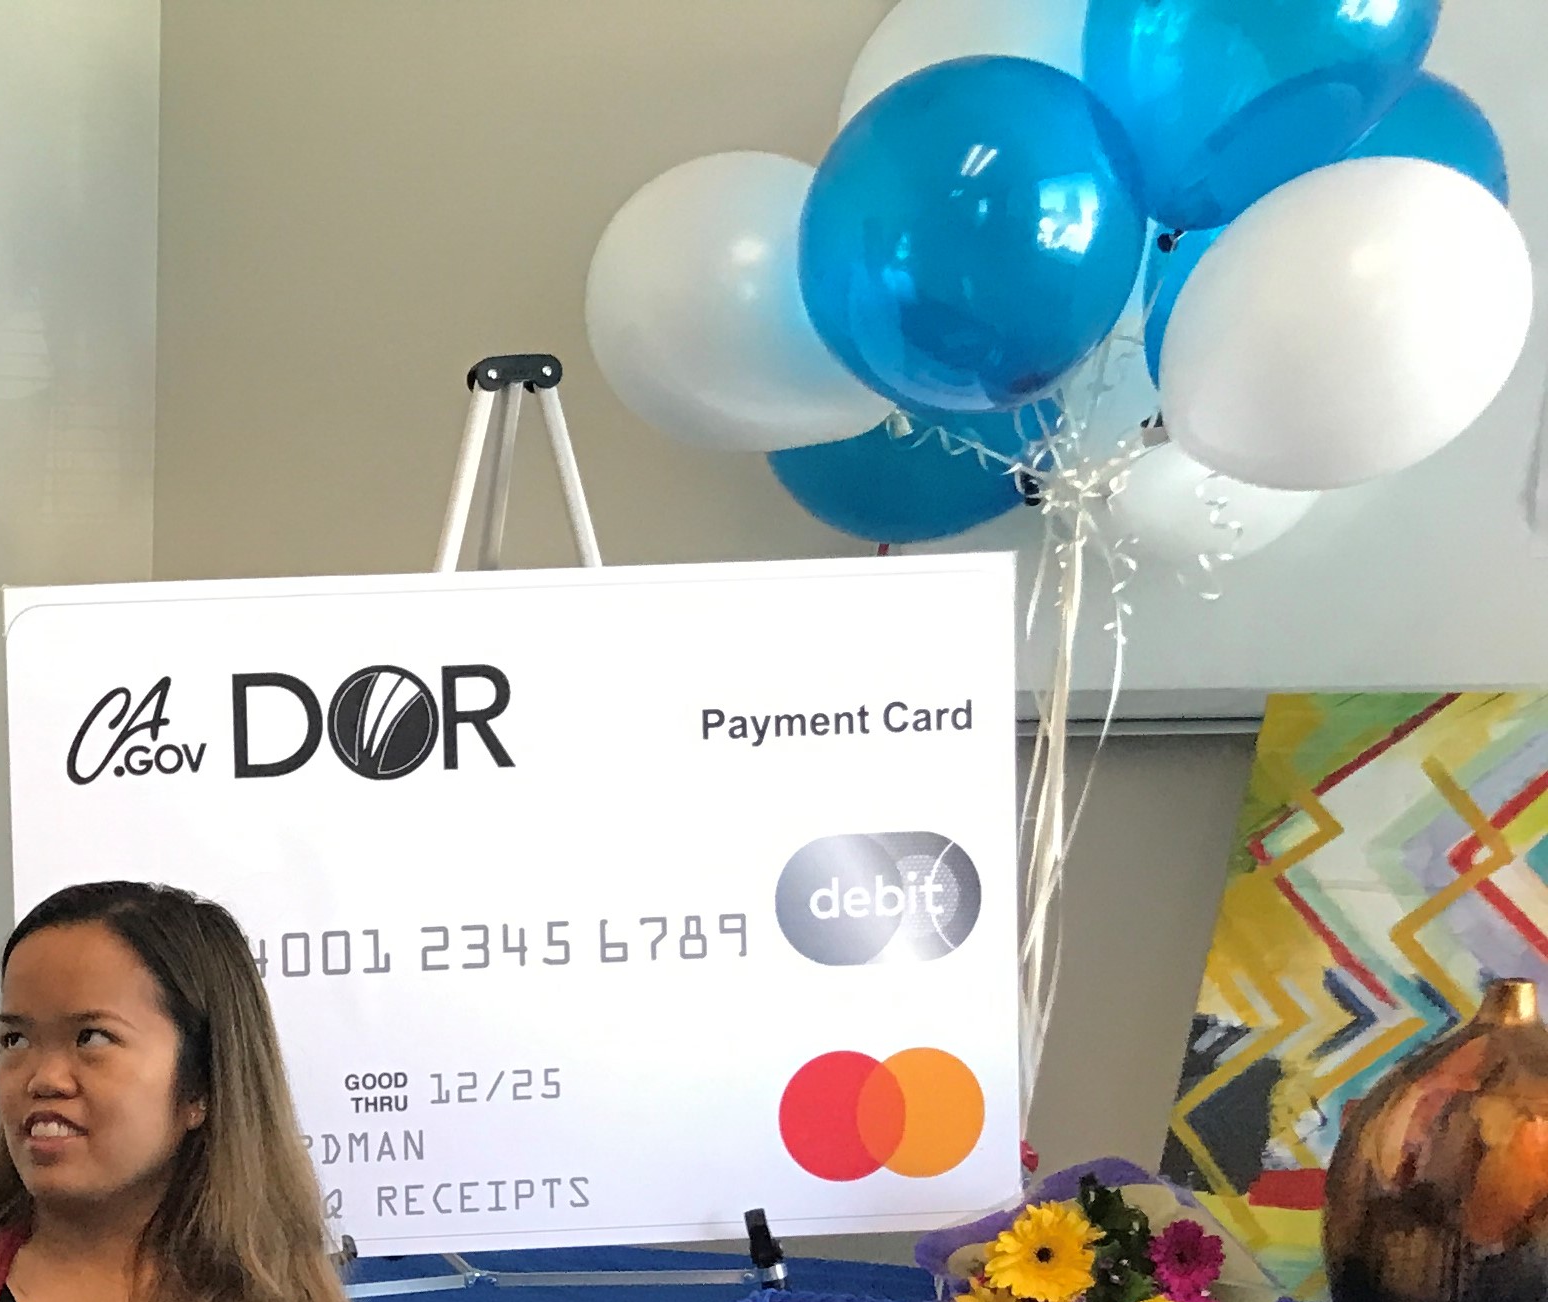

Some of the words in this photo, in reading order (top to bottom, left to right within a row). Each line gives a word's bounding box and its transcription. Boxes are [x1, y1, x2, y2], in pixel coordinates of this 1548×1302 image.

[66, 676, 172, 785] CA
[232, 664, 516, 781] DOR
[701, 704, 870, 747] Payment
[883, 700, 973, 734] Card
[114, 743, 207, 777] .GOV
[809, 871, 943, 920] debit
[420, 921, 571, 972] 2345
[600, 912, 747, 964] 6789
[344, 1072, 408, 1091] GOOD
[429, 1068, 561, 1105] 12/25
[350, 1095, 408, 1113] THRU
[300, 1129, 425, 1165] DMAN
[376, 1176, 590, 1217] RECEIPTS
